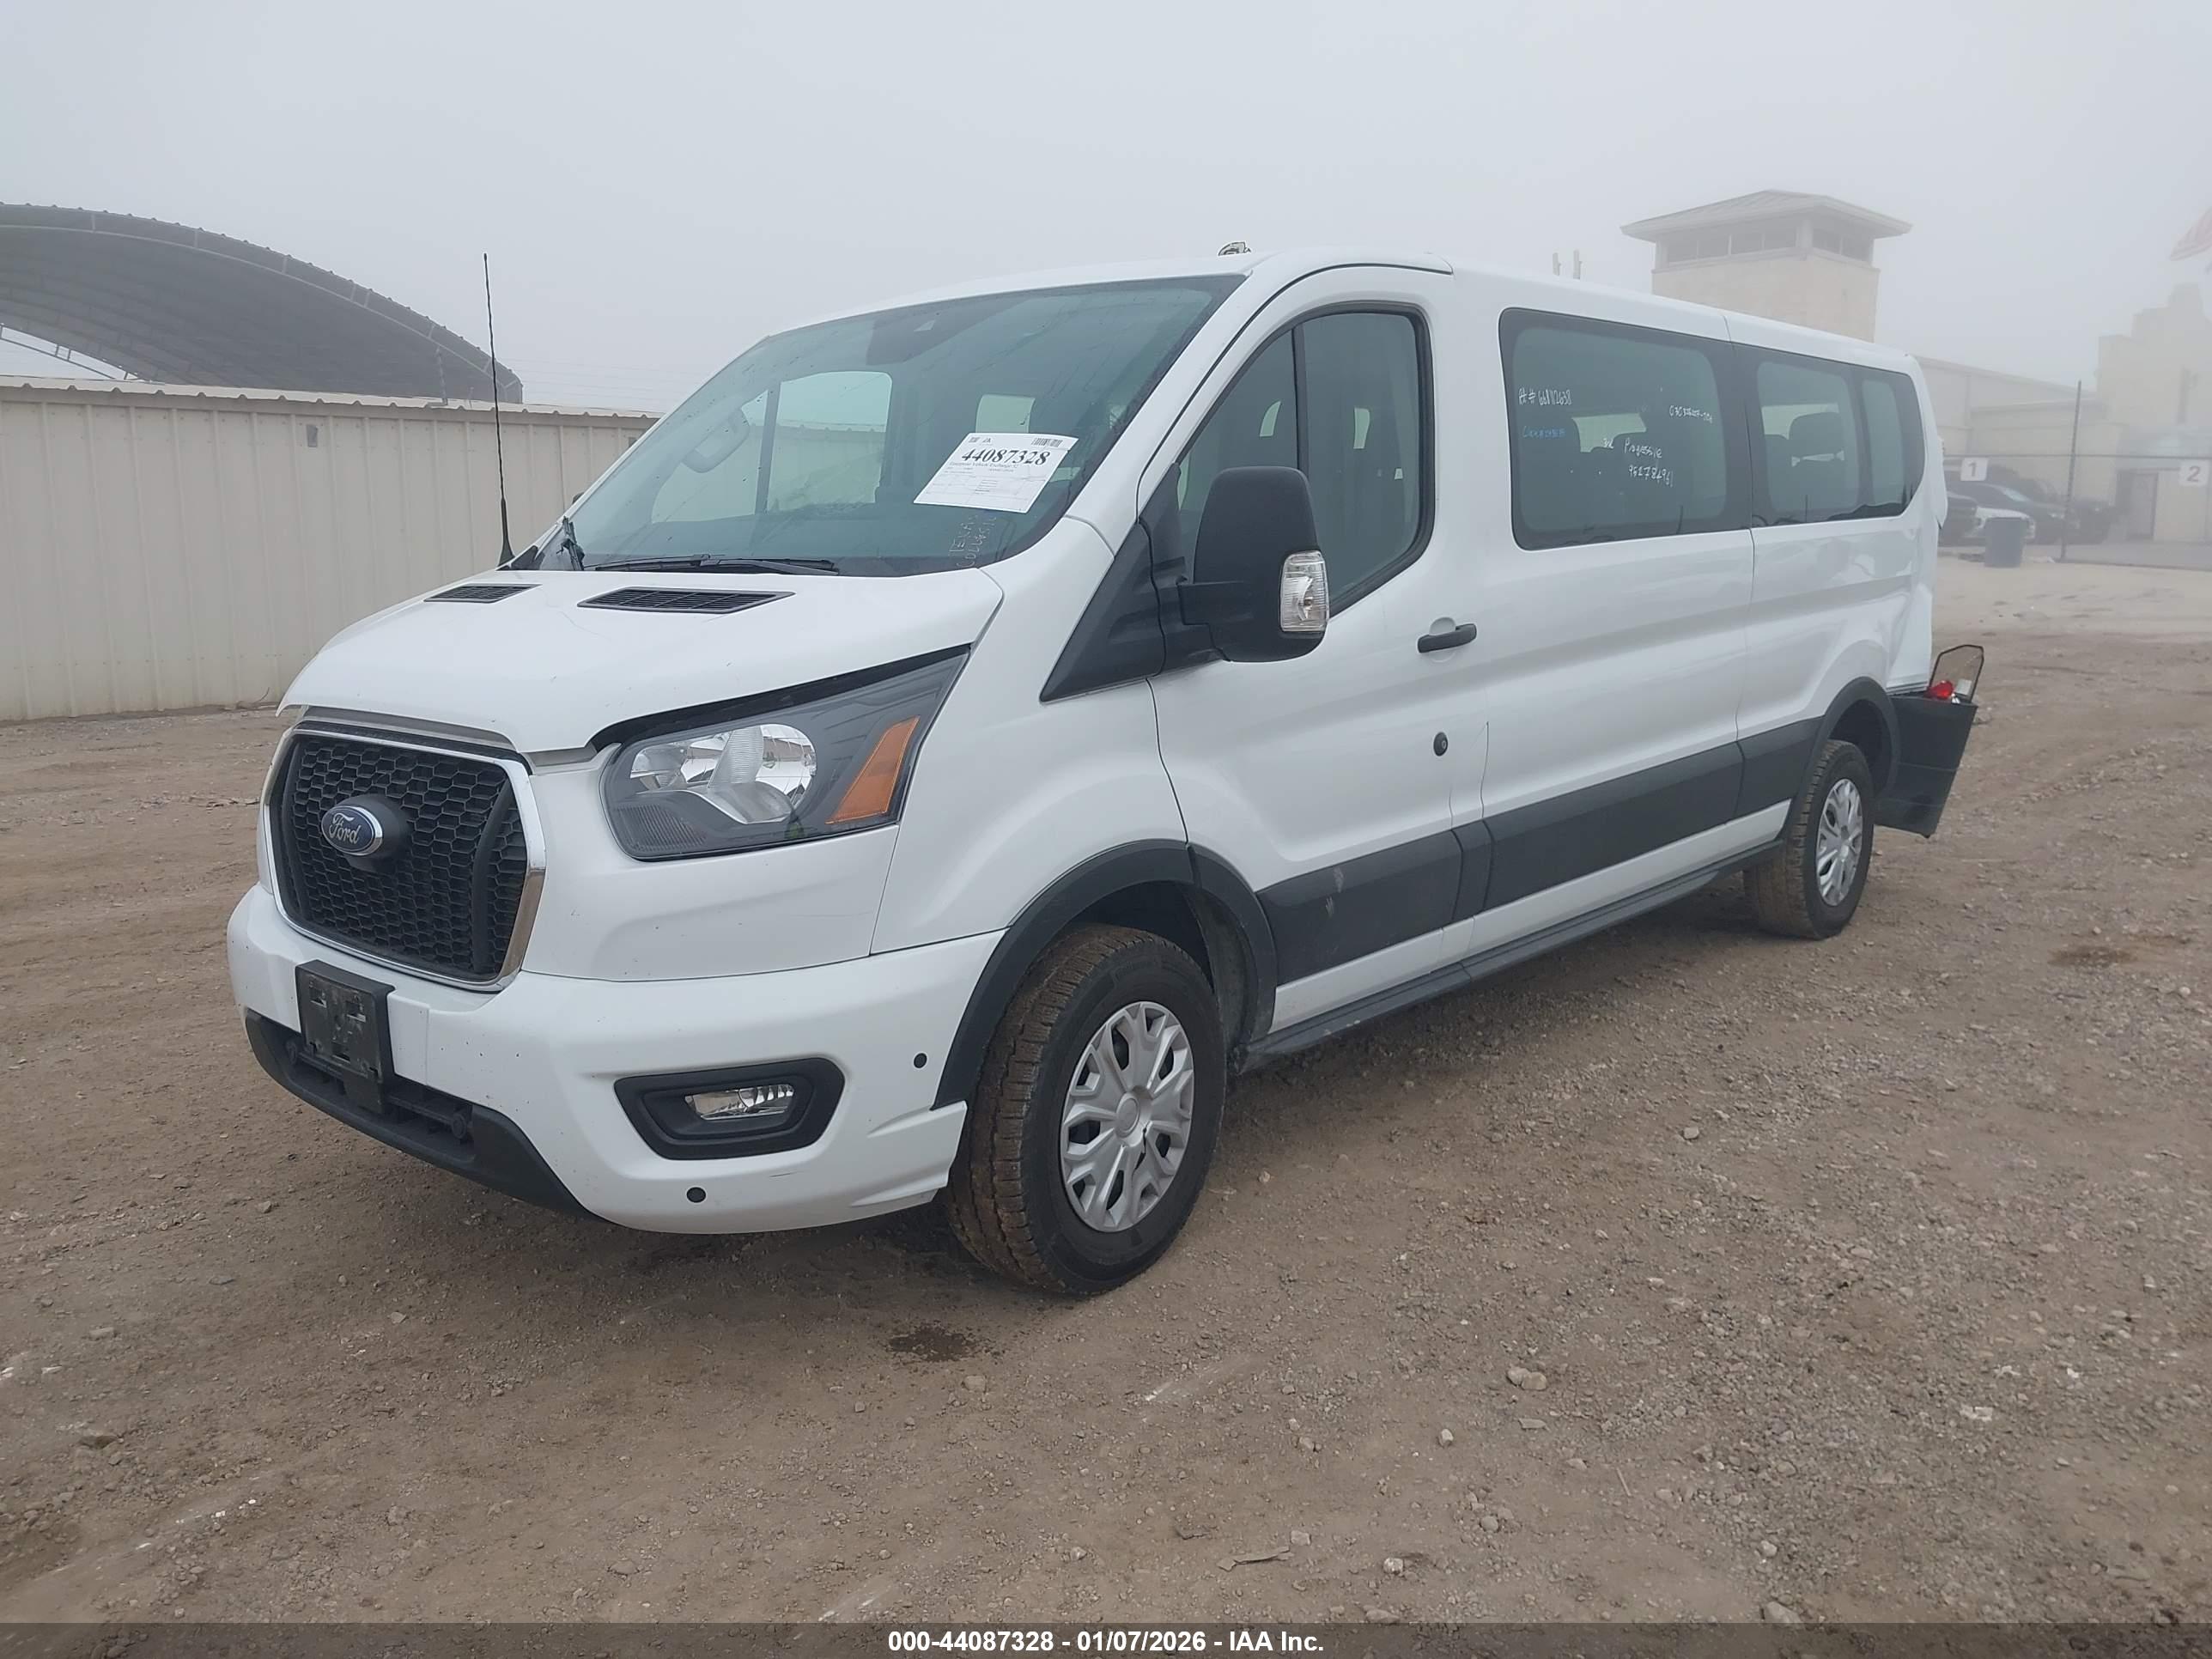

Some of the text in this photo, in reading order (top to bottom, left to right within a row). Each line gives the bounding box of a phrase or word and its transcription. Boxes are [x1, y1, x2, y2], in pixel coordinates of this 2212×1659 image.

[962, 447, 1051, 465] 44087328
[1967, 461, 1978, 477] 1
[2187, 465, 2202, 483] 2
[329, 812, 362, 844] Ford
